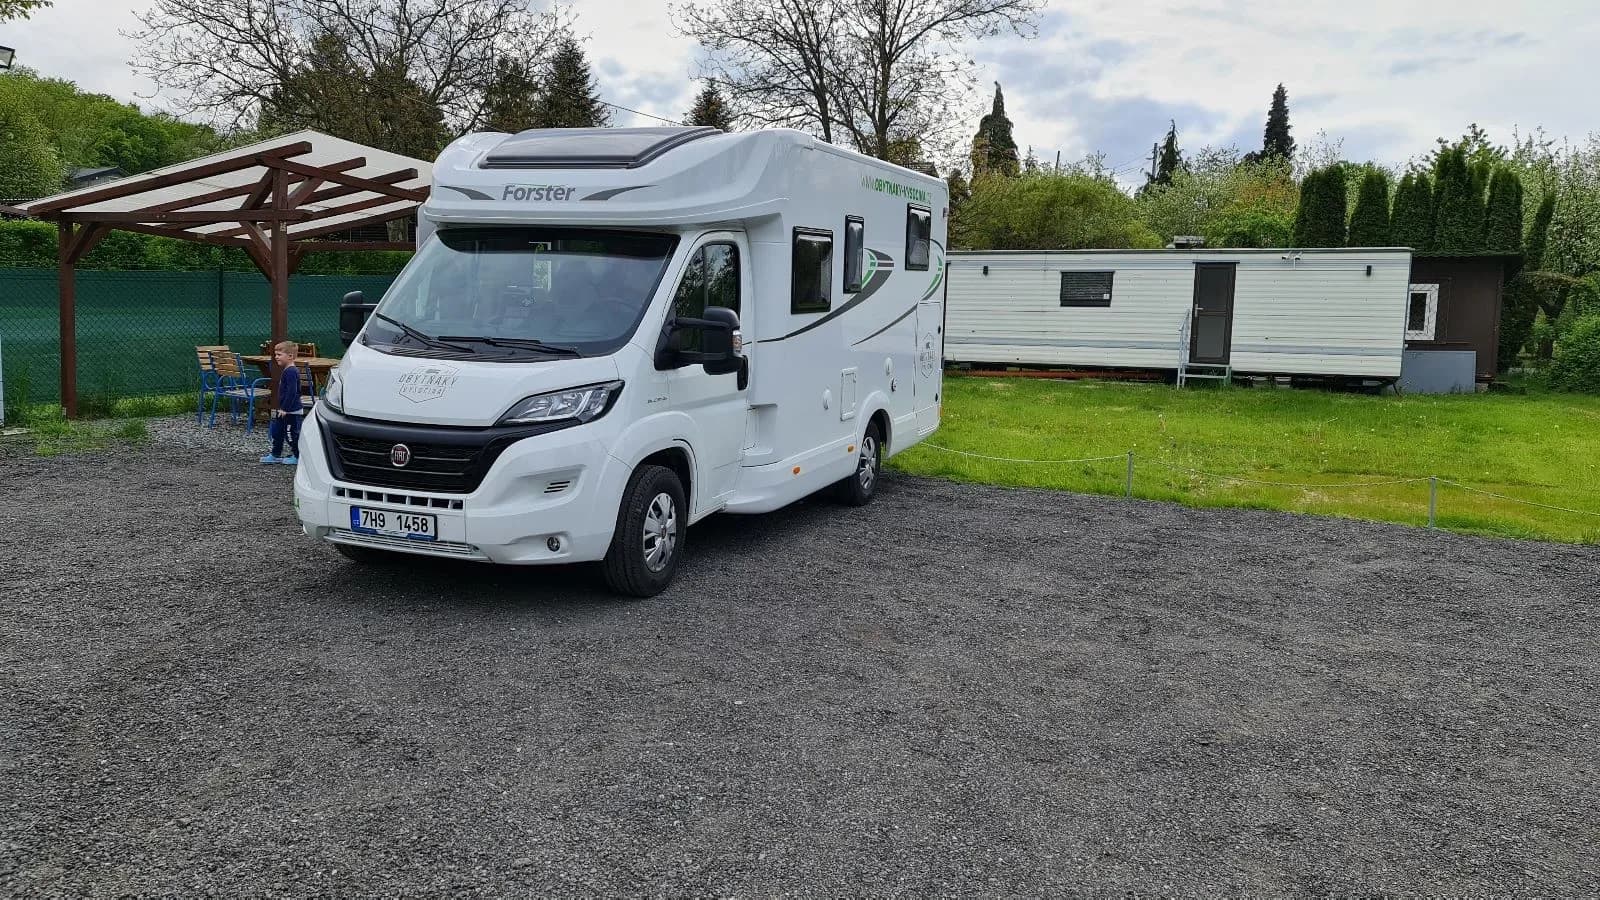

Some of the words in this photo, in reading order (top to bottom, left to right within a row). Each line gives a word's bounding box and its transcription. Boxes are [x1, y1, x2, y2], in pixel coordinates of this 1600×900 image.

[502, 184, 576, 201] Forster
[398, 373, 458, 386] OBYTNAKY
[395, 451, 407, 462] FIAT
[362, 510, 386, 528] 7H9
[397, 514, 429, 533] 1458
